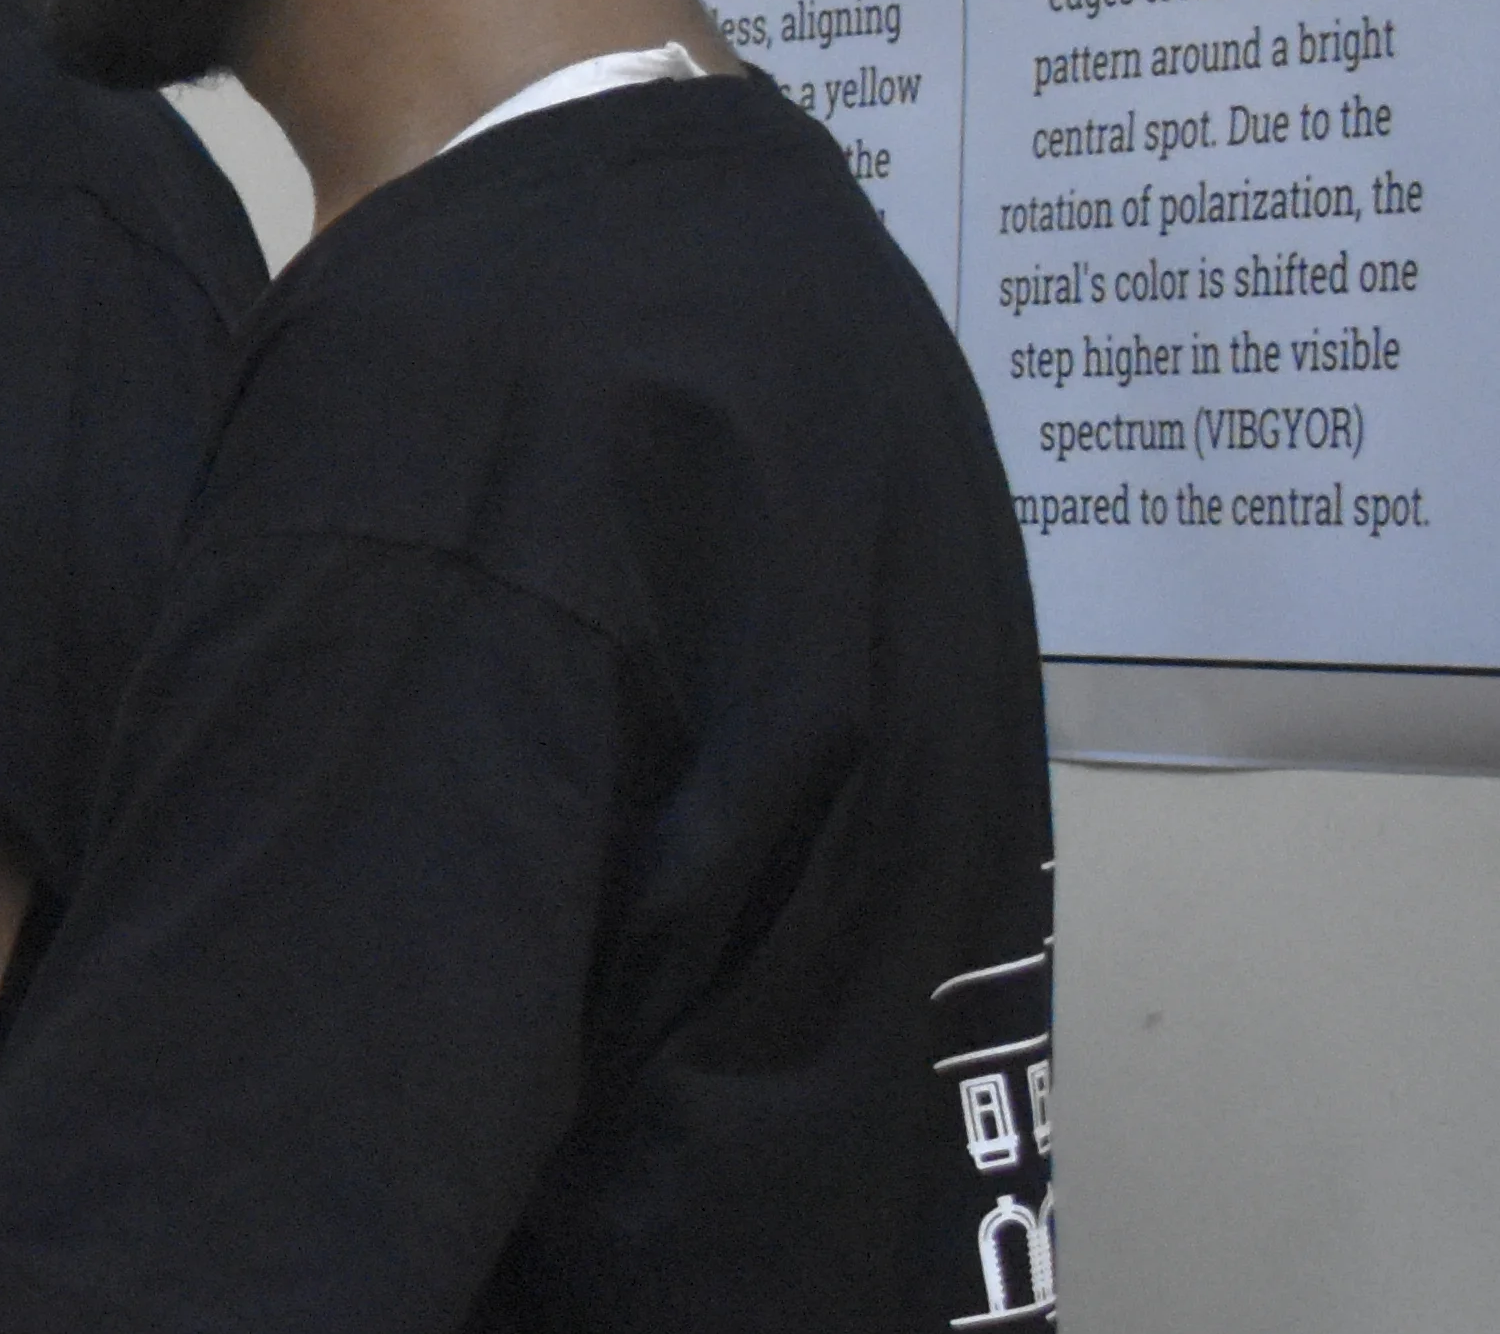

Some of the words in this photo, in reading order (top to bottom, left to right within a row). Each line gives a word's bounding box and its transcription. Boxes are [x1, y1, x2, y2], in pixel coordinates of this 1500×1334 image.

[713, 9, 773, 49] ess,
[1033, 44, 1142, 97] pattern
[1151, 25, 1261, 78] around
[1271, 33, 1289, 68] a
[1298, 15, 1396, 72] bright
[801, 83, 816, 112] a
[825, 65, 922, 120] yellow
[1032, 110, 1135, 159] central
[1144, 110, 1217, 160] spot.
[1226, 104, 1291, 147] Due
[1300, 103, 1330, 142] to
[1340, 94, 1393, 140] the
[999, 189, 1114, 234] rotation
[1121, 183, 1153, 228] of
[1159, 174, 1362, 236] polarization,
[1371, 169, 1424, 215] the
[999, 261, 1106, 316] spiral's
[1114, 257, 1189, 302] color
[1198, 257, 1224, 299] is
[1234, 250, 1348, 298] shifted
[1359, 257, 1419, 294] one
[1010, 343, 1074, 388] step
[1082, 334, 1183, 387] higher
[1192, 331, 1221, 375] in
[1230, 329, 1282, 374] the
[1291, 326, 1400, 372] visible
[1040, 411, 1187, 462] spectrum
[1194, 402, 1366, 460] (VIBGYOR)
[1012, 482, 1130, 536] mpared
[1140, 489, 1168, 527] to
[1176, 482, 1223, 527] the
[1232, 481, 1342, 527] central
[1353, 486, 1430, 537] spot.
